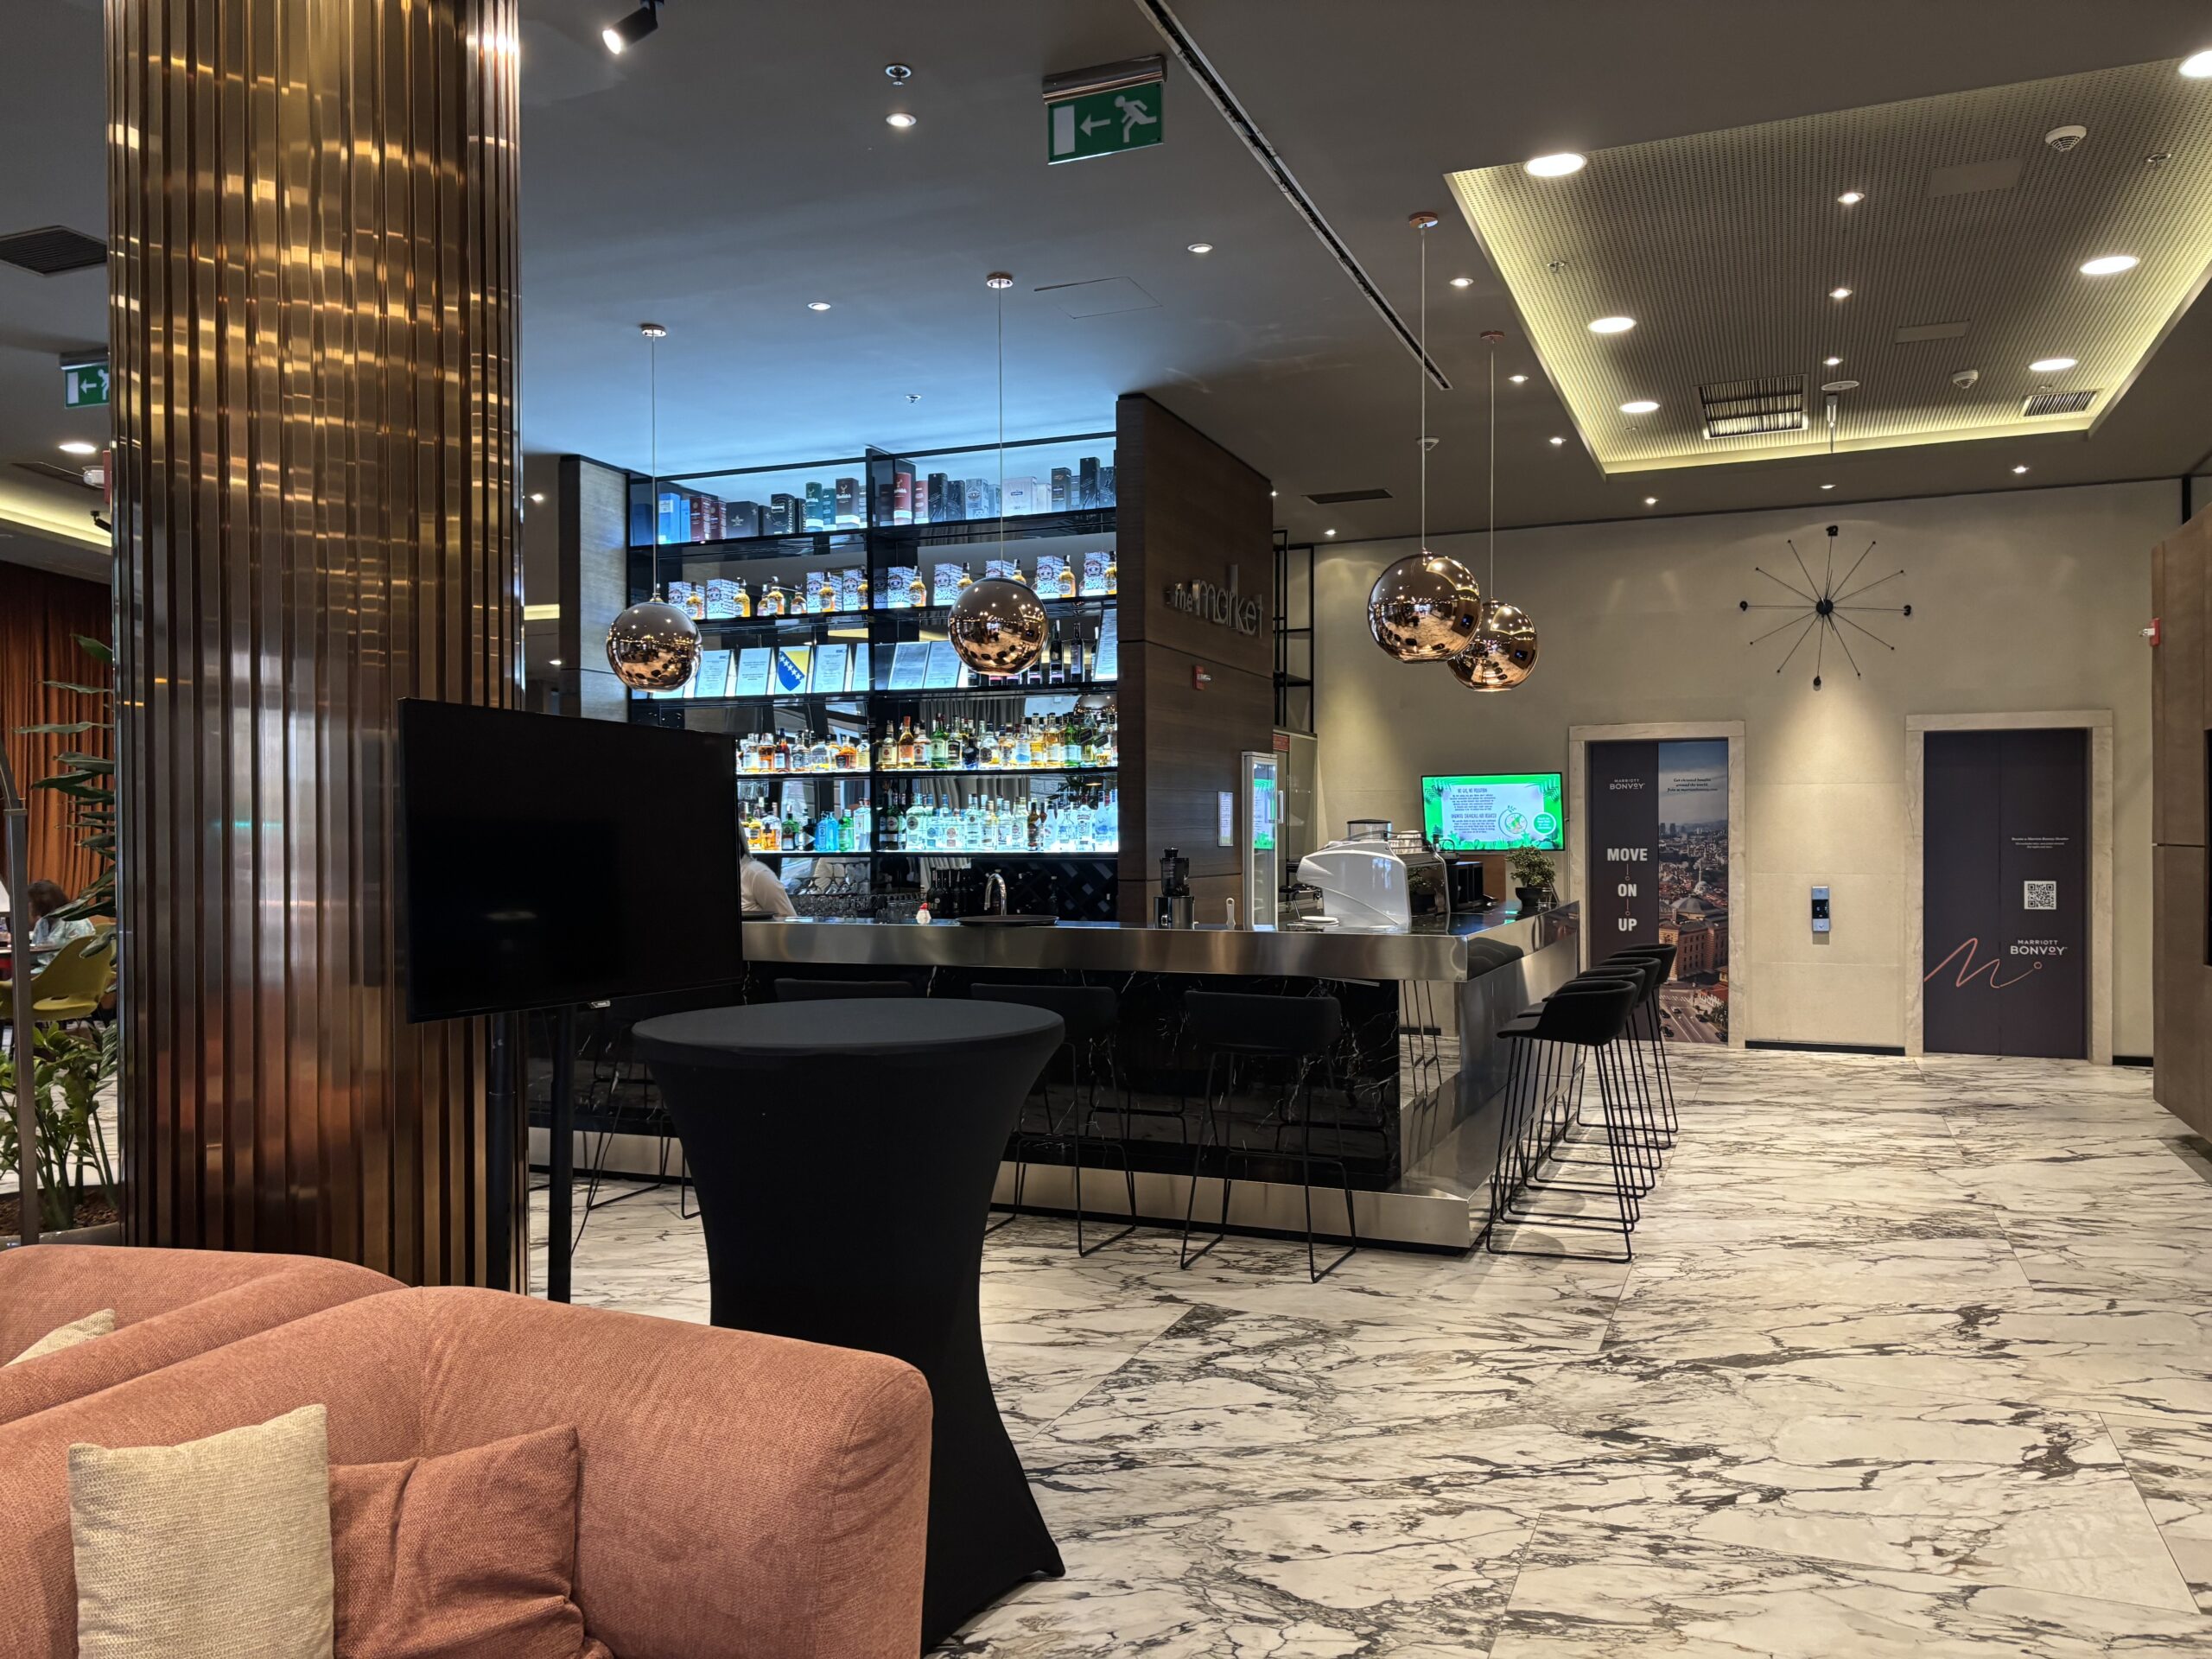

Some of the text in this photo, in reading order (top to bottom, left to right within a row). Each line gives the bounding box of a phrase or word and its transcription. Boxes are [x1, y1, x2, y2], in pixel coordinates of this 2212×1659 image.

[1193, 564, 1264, 639] market
[1606, 848, 1648, 861] MOVE
[1618, 883, 1637, 897] ON
[1618, 918, 1637, 931] UP
[2010, 945, 2066, 956] BONVOY
